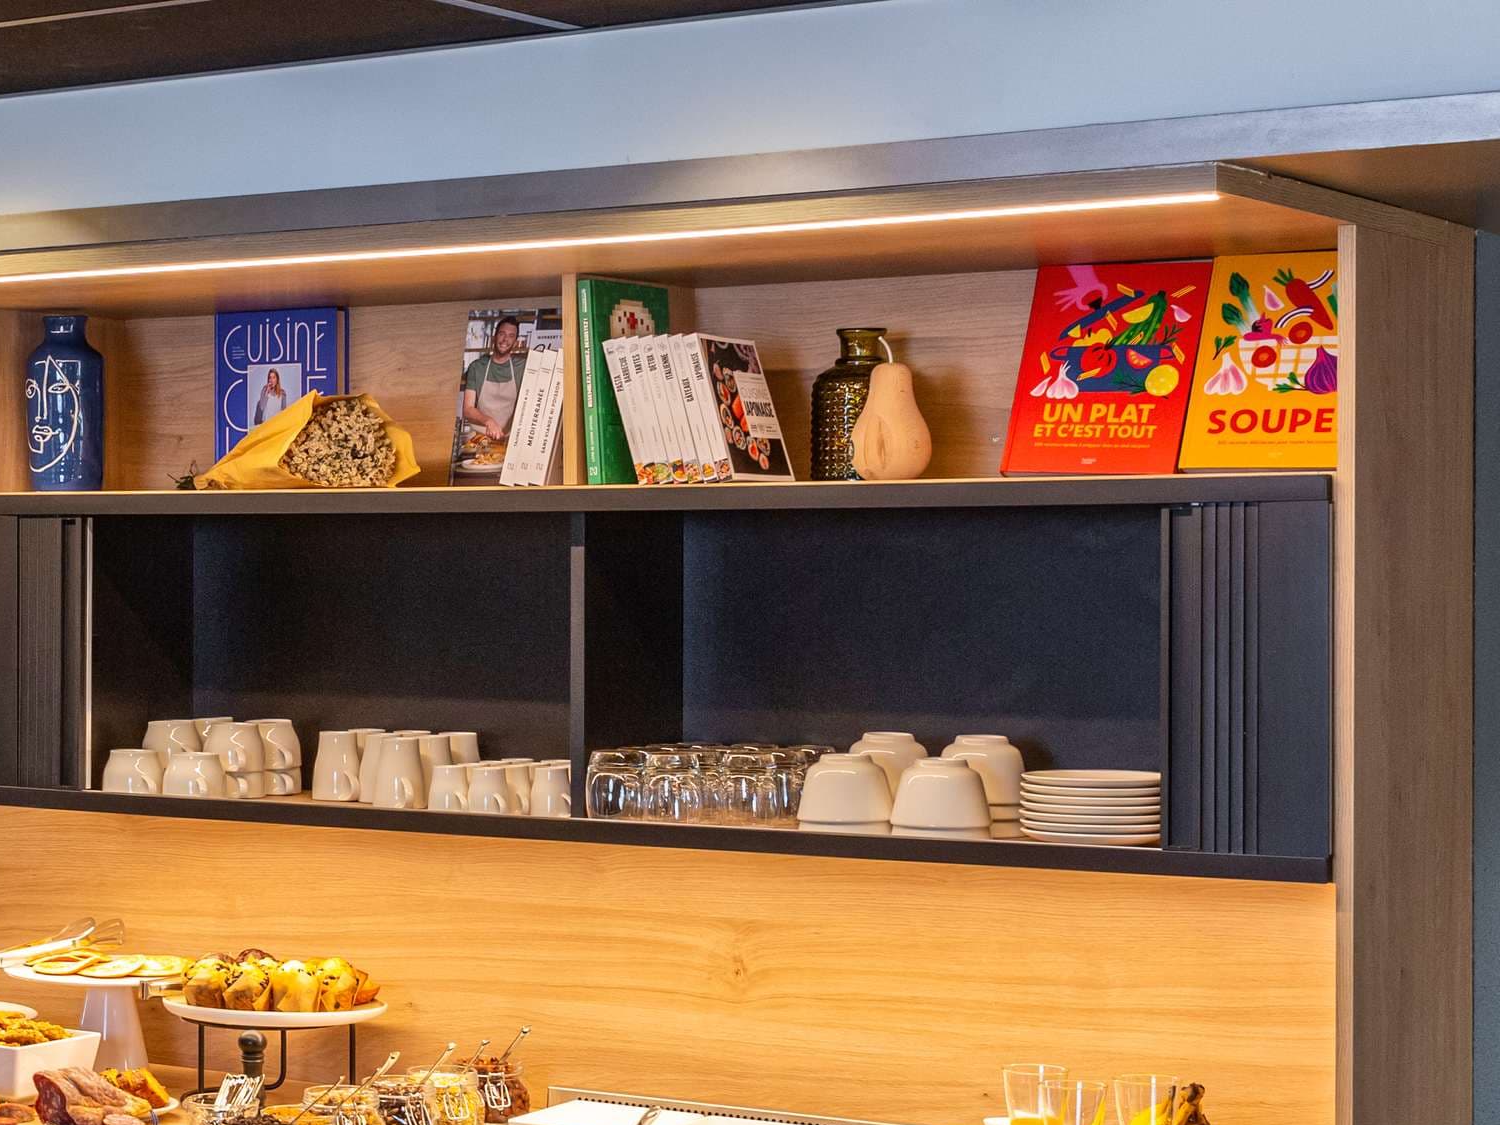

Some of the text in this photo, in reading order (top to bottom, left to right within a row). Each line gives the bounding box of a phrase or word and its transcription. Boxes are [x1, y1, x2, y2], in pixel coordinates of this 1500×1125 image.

[632, 353, 644, 375] TARTES
[660, 352, 674, 381] ITALIENNE
[613, 375, 624, 393] PASTA
[1043, 403, 1157, 423] UN PLAT
[1033, 423, 1157, 439] ET C'EST TOUT
